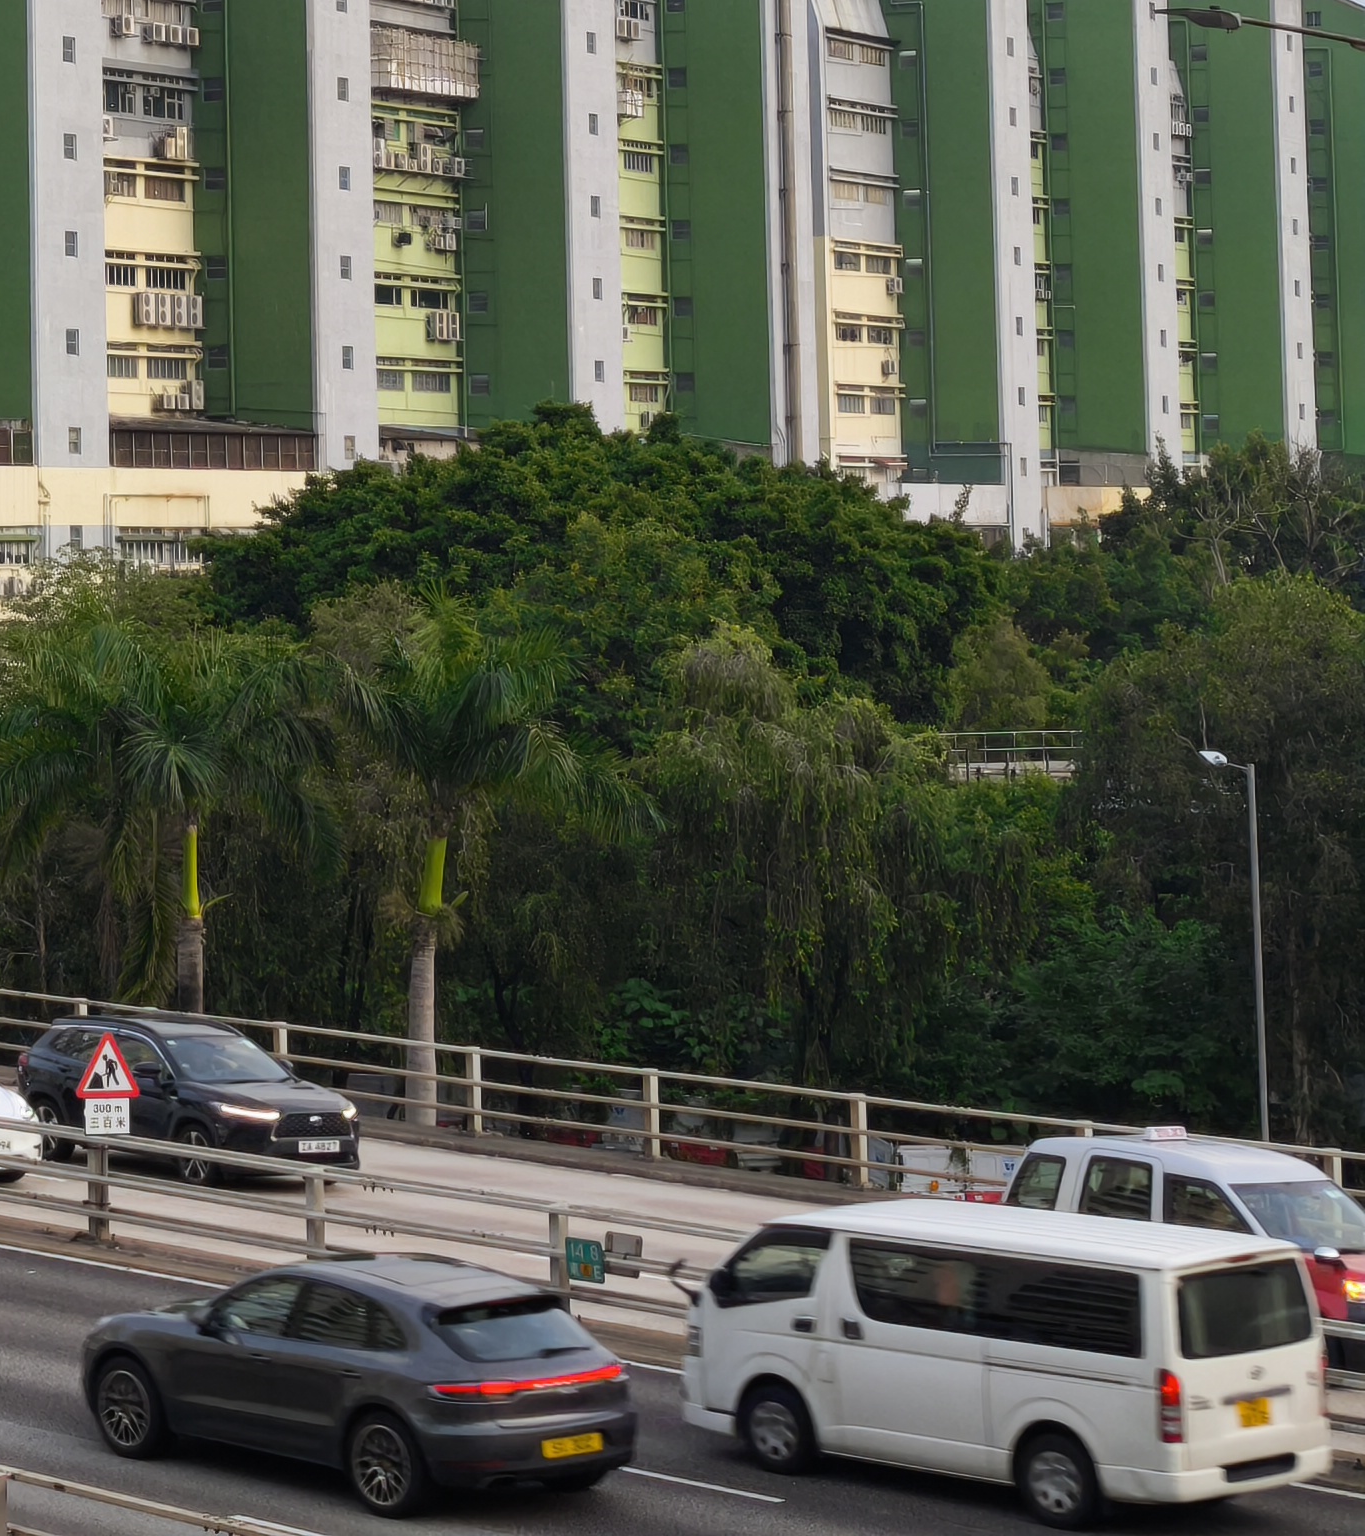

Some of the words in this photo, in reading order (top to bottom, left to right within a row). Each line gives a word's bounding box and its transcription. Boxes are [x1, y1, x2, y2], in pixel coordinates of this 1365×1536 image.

[92, 1103, 112, 1114] 300
[114, 1105, 123, 1113] m
[89, 1115, 127, 1129] 三百米
